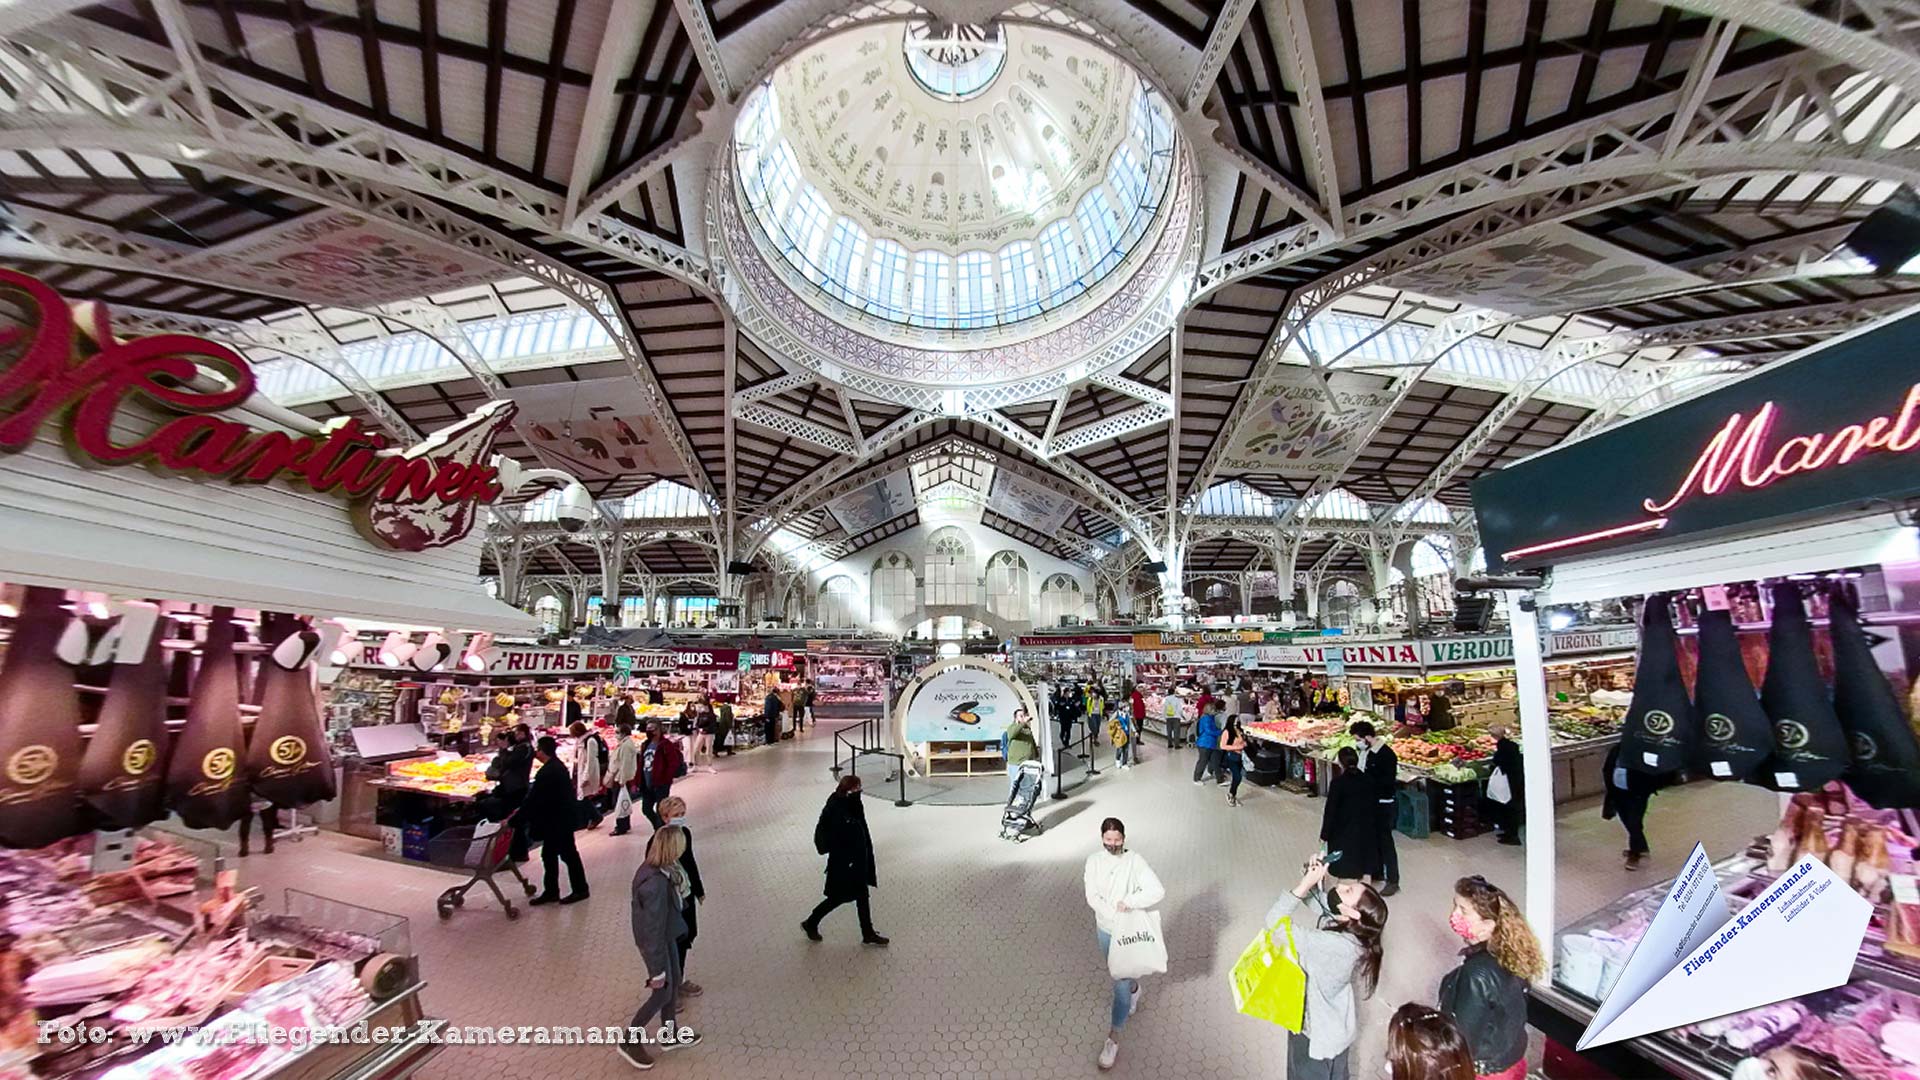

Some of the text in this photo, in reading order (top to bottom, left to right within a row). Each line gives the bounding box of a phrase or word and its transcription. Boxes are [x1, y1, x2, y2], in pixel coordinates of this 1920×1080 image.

[1431, 637, 1546, 662] VERDU
[1553, 634, 1608, 651] VIRGINIA
[585, 654, 616, 671] RO
[1303, 645, 1420, 663] VIGINIA
